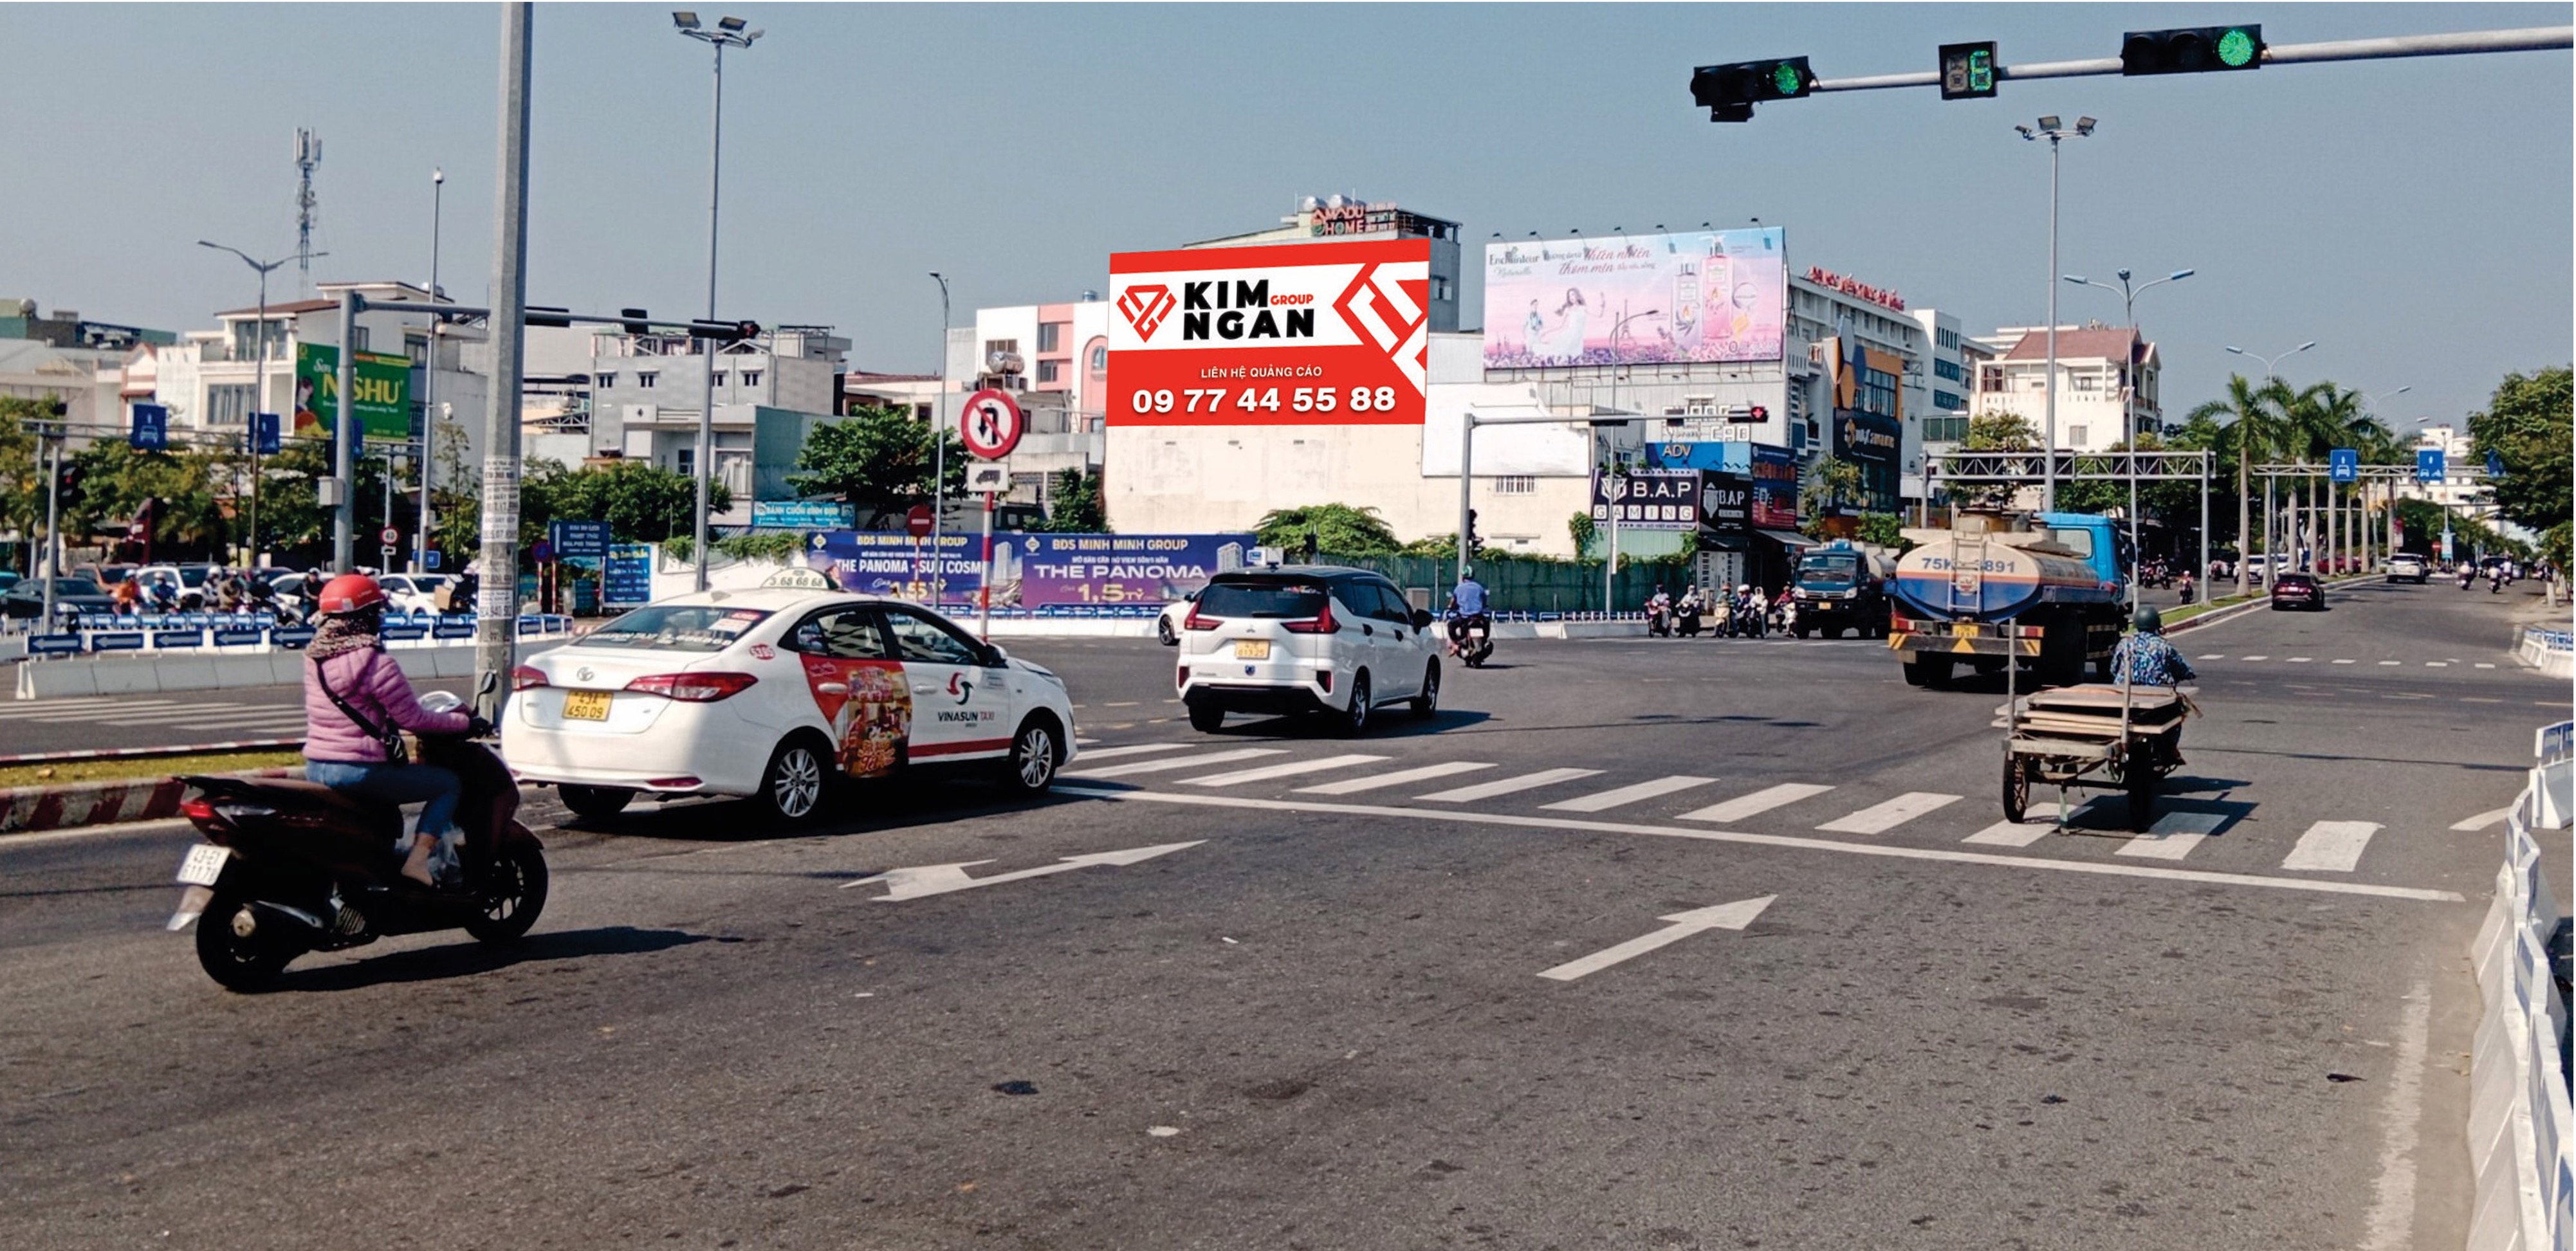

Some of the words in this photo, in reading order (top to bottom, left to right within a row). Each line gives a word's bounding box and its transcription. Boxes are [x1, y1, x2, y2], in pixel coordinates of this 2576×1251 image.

[1325, 219, 1364, 235] HOME
[1184, 280, 1268, 310] KIM
[1271, 294, 1314, 306] GROUP
[1183, 309, 1314, 340] NGAN
[1201, 367, 1227, 378] LIÊN
[1231, 365, 1246, 379] HỆ
[1250, 364, 1293, 378] QUẢNG
[1296, 364, 1322, 377] CÁO
[323, 372, 398, 404] NSHU
[1132, 389, 1174, 413] 09
[1184, 389, 1227, 412] 77
[1237, 388, 1280, 412] 44
[1293, 387, 1336, 411] 55
[1350, 387, 1395, 410] 88
[1662, 444, 1692, 458] ADV
[1633, 481, 1691, 498] B.A.P
[1596, 507, 1691, 520] GAMING
[878, 536, 903, 545] MINH
[1078, 539, 1110, 550] MINH
[1113, 540, 1144, 550] MINH
[1147, 540, 1188, 550] GROUP
[836, 559, 856, 572] THE
[860, 559, 908, 572] PANOMA
[946, 560, 982, 574] COSM
[1034, 565, 1085, 578] THE
[1093, 566, 1206, 578] PANOMA
[1078, 583, 1125, 603] 1,5
[938, 711, 978, 722] VINASUN
[980, 711, 995, 721] TAXI
